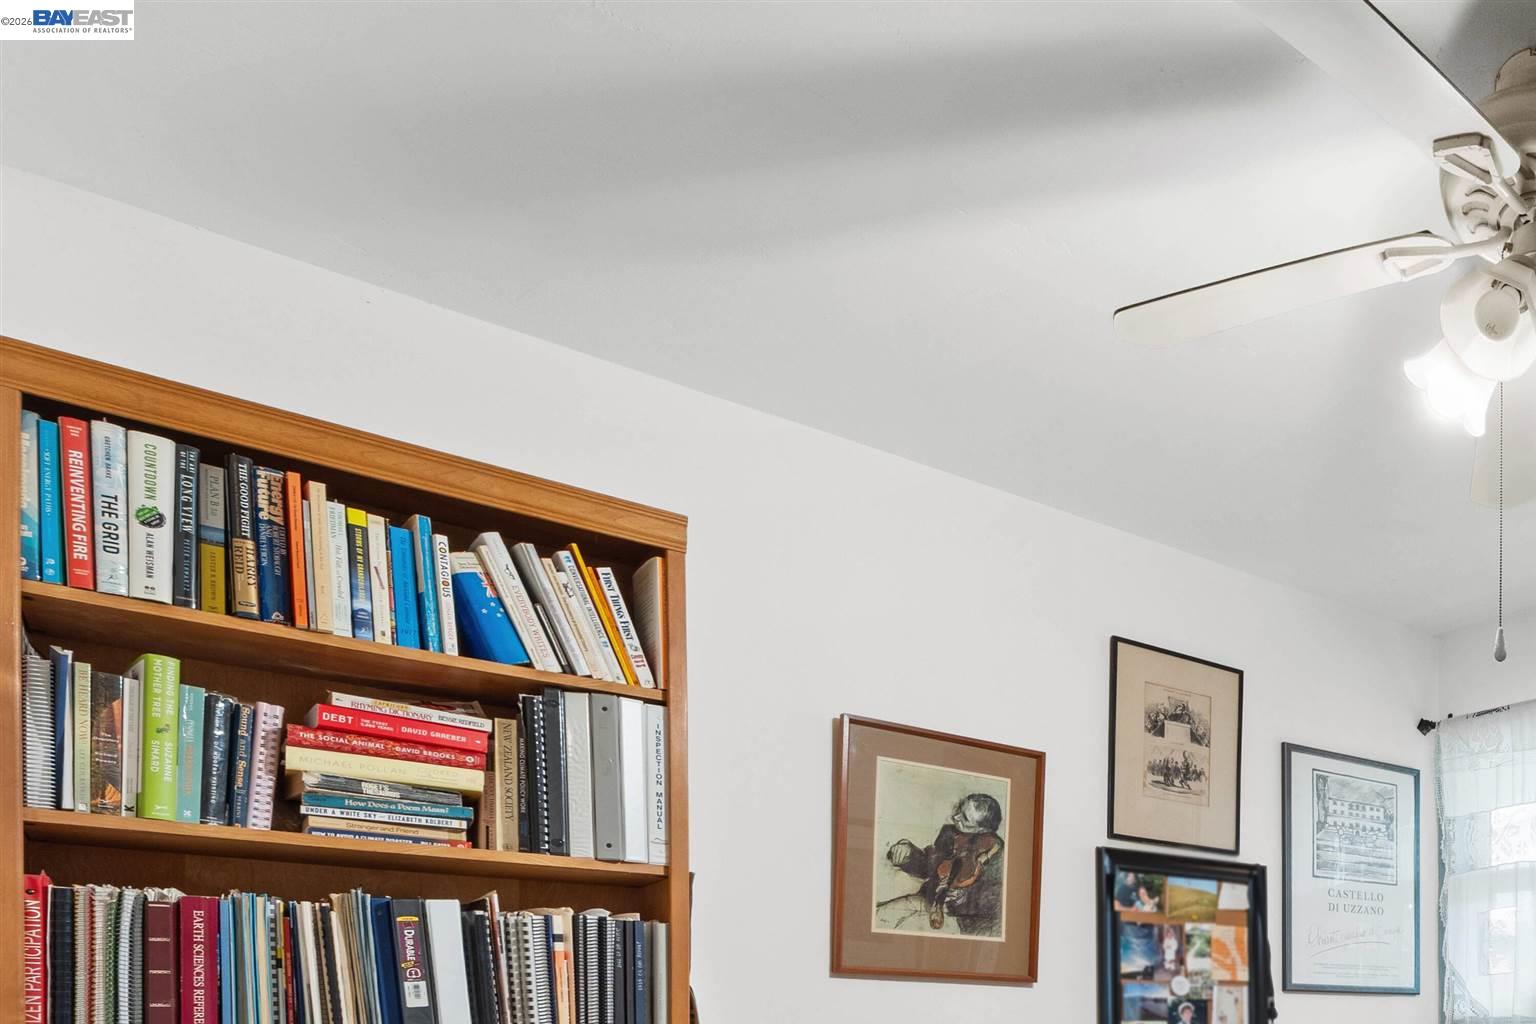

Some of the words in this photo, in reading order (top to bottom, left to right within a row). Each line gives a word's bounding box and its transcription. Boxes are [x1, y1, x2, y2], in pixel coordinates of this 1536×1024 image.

[144, 444, 157, 501] COUNTDOWN
[238, 463, 248, 482] THE
[68, 450, 85, 531] REINVENTING
[181, 475, 193, 502] LONG
[240, 483, 249, 508] GOOD
[101, 494, 118, 518] THE
[182, 506, 193, 534] VIEW
[102, 522, 119, 554] GRID
[241, 510, 250, 539] FIGHT
[73, 534, 88, 560] FIRE
[146, 532, 154, 548] ALAN
[145, 550, 154, 579] WEISMAN
[234, 545, 244, 574] REID
[438, 541, 451, 598] CONTAGIOUS
[601, 572, 614, 591] FIRST
[608, 594, 624, 619] THINGS
[620, 620, 633, 641] FIRST
[153, 658, 162, 693] MOTHER
[152, 697, 161, 717] TREE
[322, 712, 354, 724] DEBT
[239, 707, 250, 736] Sound
[401, 726, 428, 736] DAVID
[430, 732, 467, 743] GRAEBER
[503, 723, 513, 744] NEW
[239, 738, 247, 757] and
[300, 732, 315, 740] THE
[318, 734, 349, 744] SOCIAL
[352, 739, 385, 749] ANIMAL
[151, 740, 159, 773] SIMARD
[163, 741, 172, 782] SUZANNE
[503, 745, 513, 785] ZEALAND
[237, 759, 247, 787] Sense
[305, 806, 328, 815] UNDER
[340, 810, 360, 818] WHITE
[388, 814, 423, 823] ELIZABETH
[425, 818, 453, 827] KOLBERT
[504, 787, 514, 821] SOCIETY
[346, 822, 377, 832] Stranger
[393, 826, 419, 835] Friend
[1328, 888, 1384, 902] CASTELLO
[1328, 903, 1339, 913] DI
[1343, 904, 1384, 916] UZZANO
[193, 910, 204, 941] EARTH
[24, 900, 41, 992] PARTICIPATION
[193, 943, 204, 987] SCIENCES
